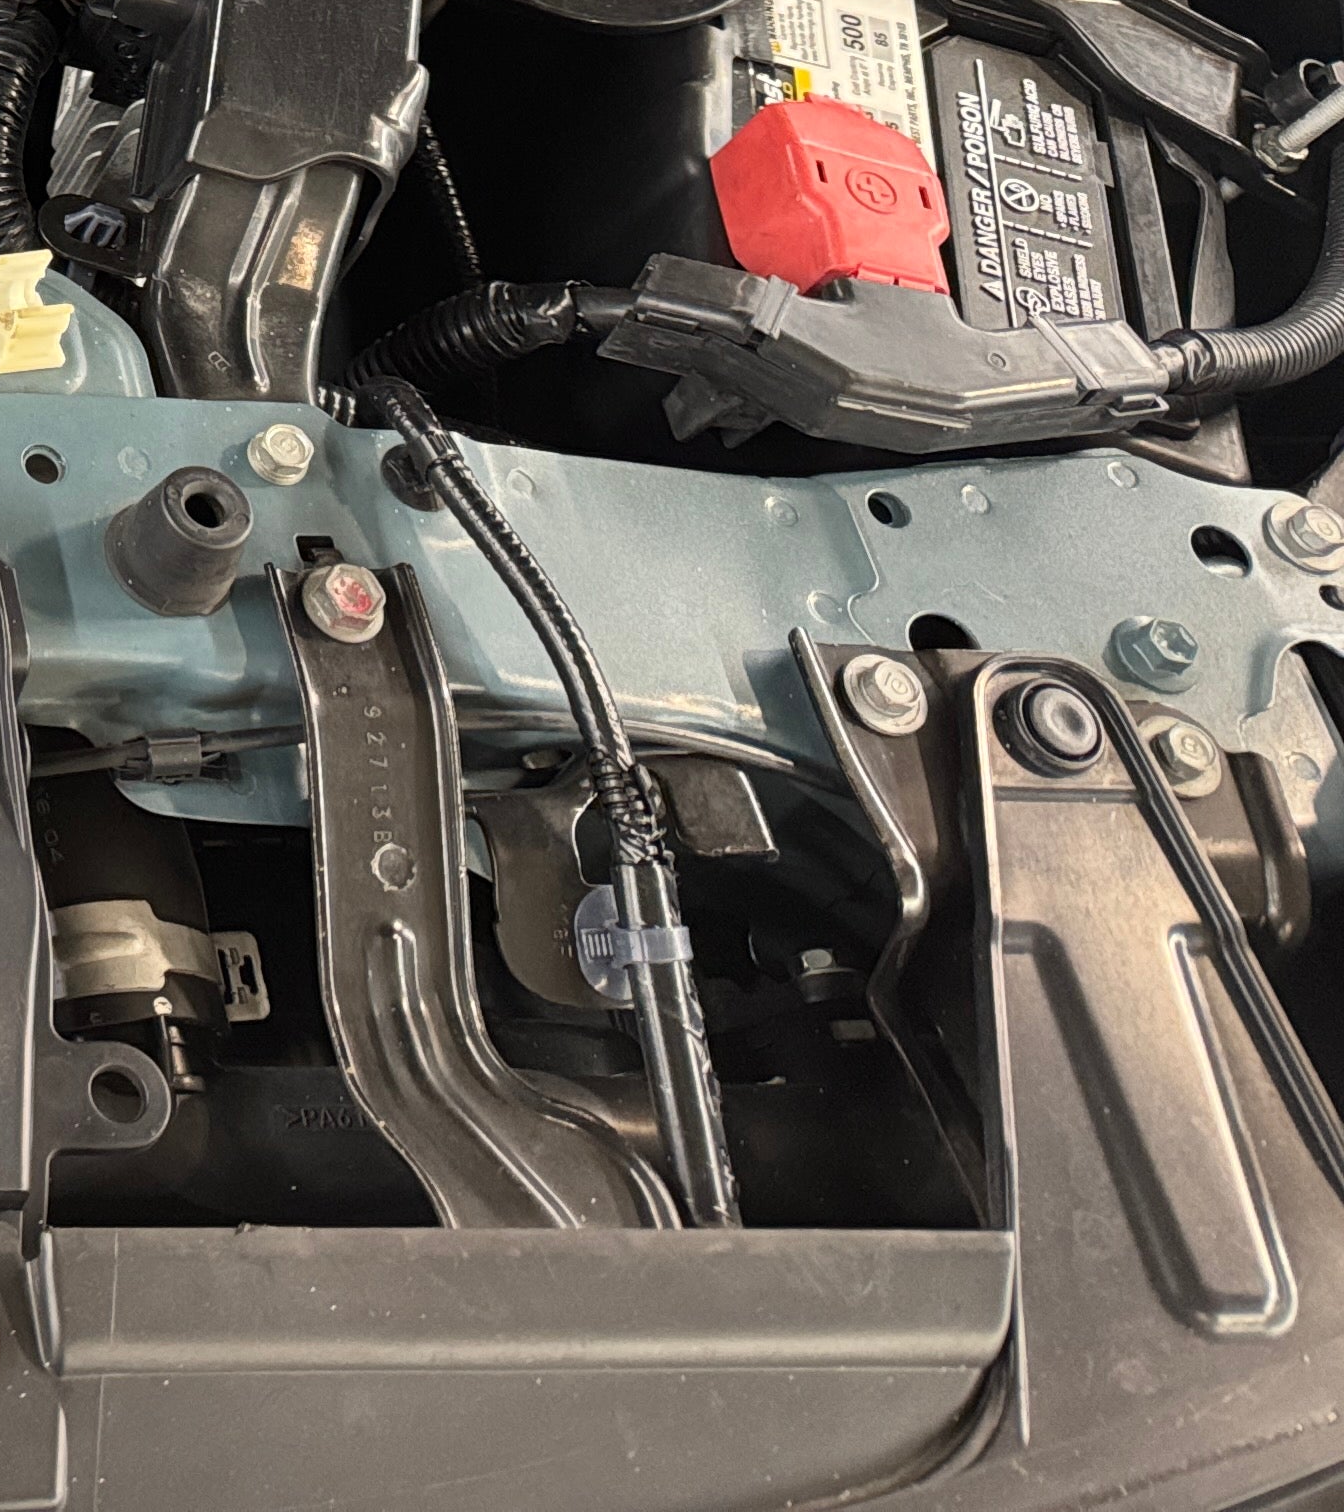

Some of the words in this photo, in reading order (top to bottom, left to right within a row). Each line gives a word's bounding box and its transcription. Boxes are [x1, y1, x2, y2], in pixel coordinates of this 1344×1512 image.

[840, 14, 866, 52] 500
[874, 32, 890, 48] 85
[1039, 193, 1054, 213] NO
[1014, 237, 1033, 279] SHIELD
[1030, 251, 1047, 283] EYES
[1043, 249, 1066, 313] EXPLOSIVE
[1061, 276, 1080, 317] GASES
